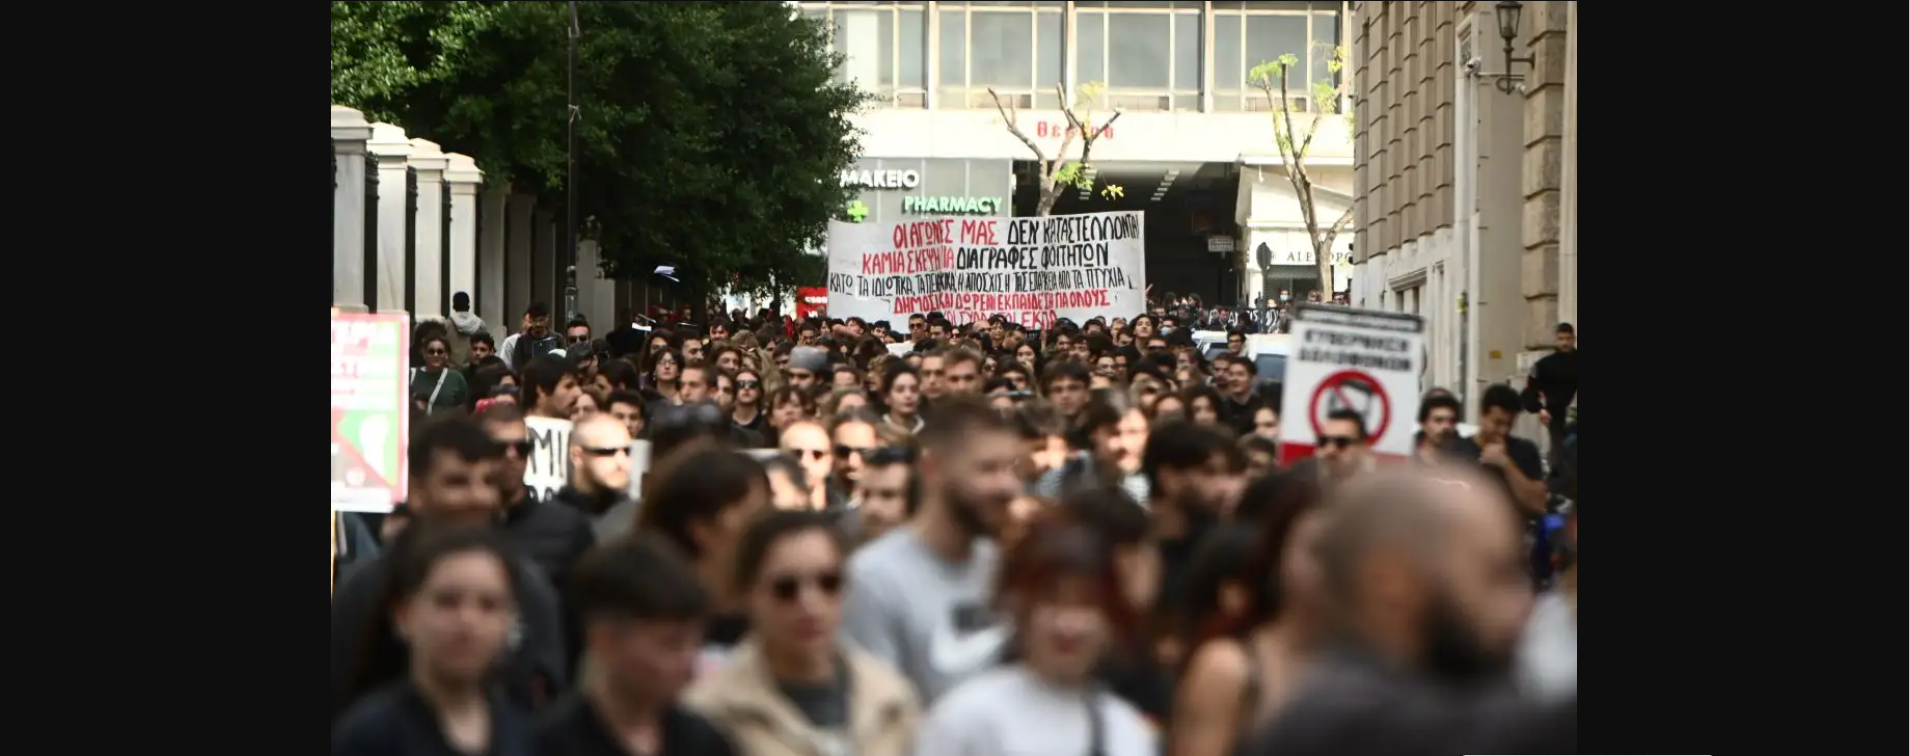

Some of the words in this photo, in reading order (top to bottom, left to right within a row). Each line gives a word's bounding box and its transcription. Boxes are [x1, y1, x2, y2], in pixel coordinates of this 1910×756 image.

[839, 169, 919, 188] ΜΑΚΕΙΟ
[904, 196, 1003, 212] PHARMACY
[893, 222, 908, 249] ΟΙ
[961, 219, 999, 245] ΜΑΣ
[1007, 219, 1039, 245] ΔΕΝ
[862, 252, 905, 275] ΚΑΜΙΑ
[957, 246, 1038, 270] ΔΙΑΓΡΑΦΕΣ
[857, 275, 869, 296] ΤΑ
[1072, 270, 1084, 289] ΤΑ
[1086, 266, 1125, 289] ΠΤΥΧΙΑ
